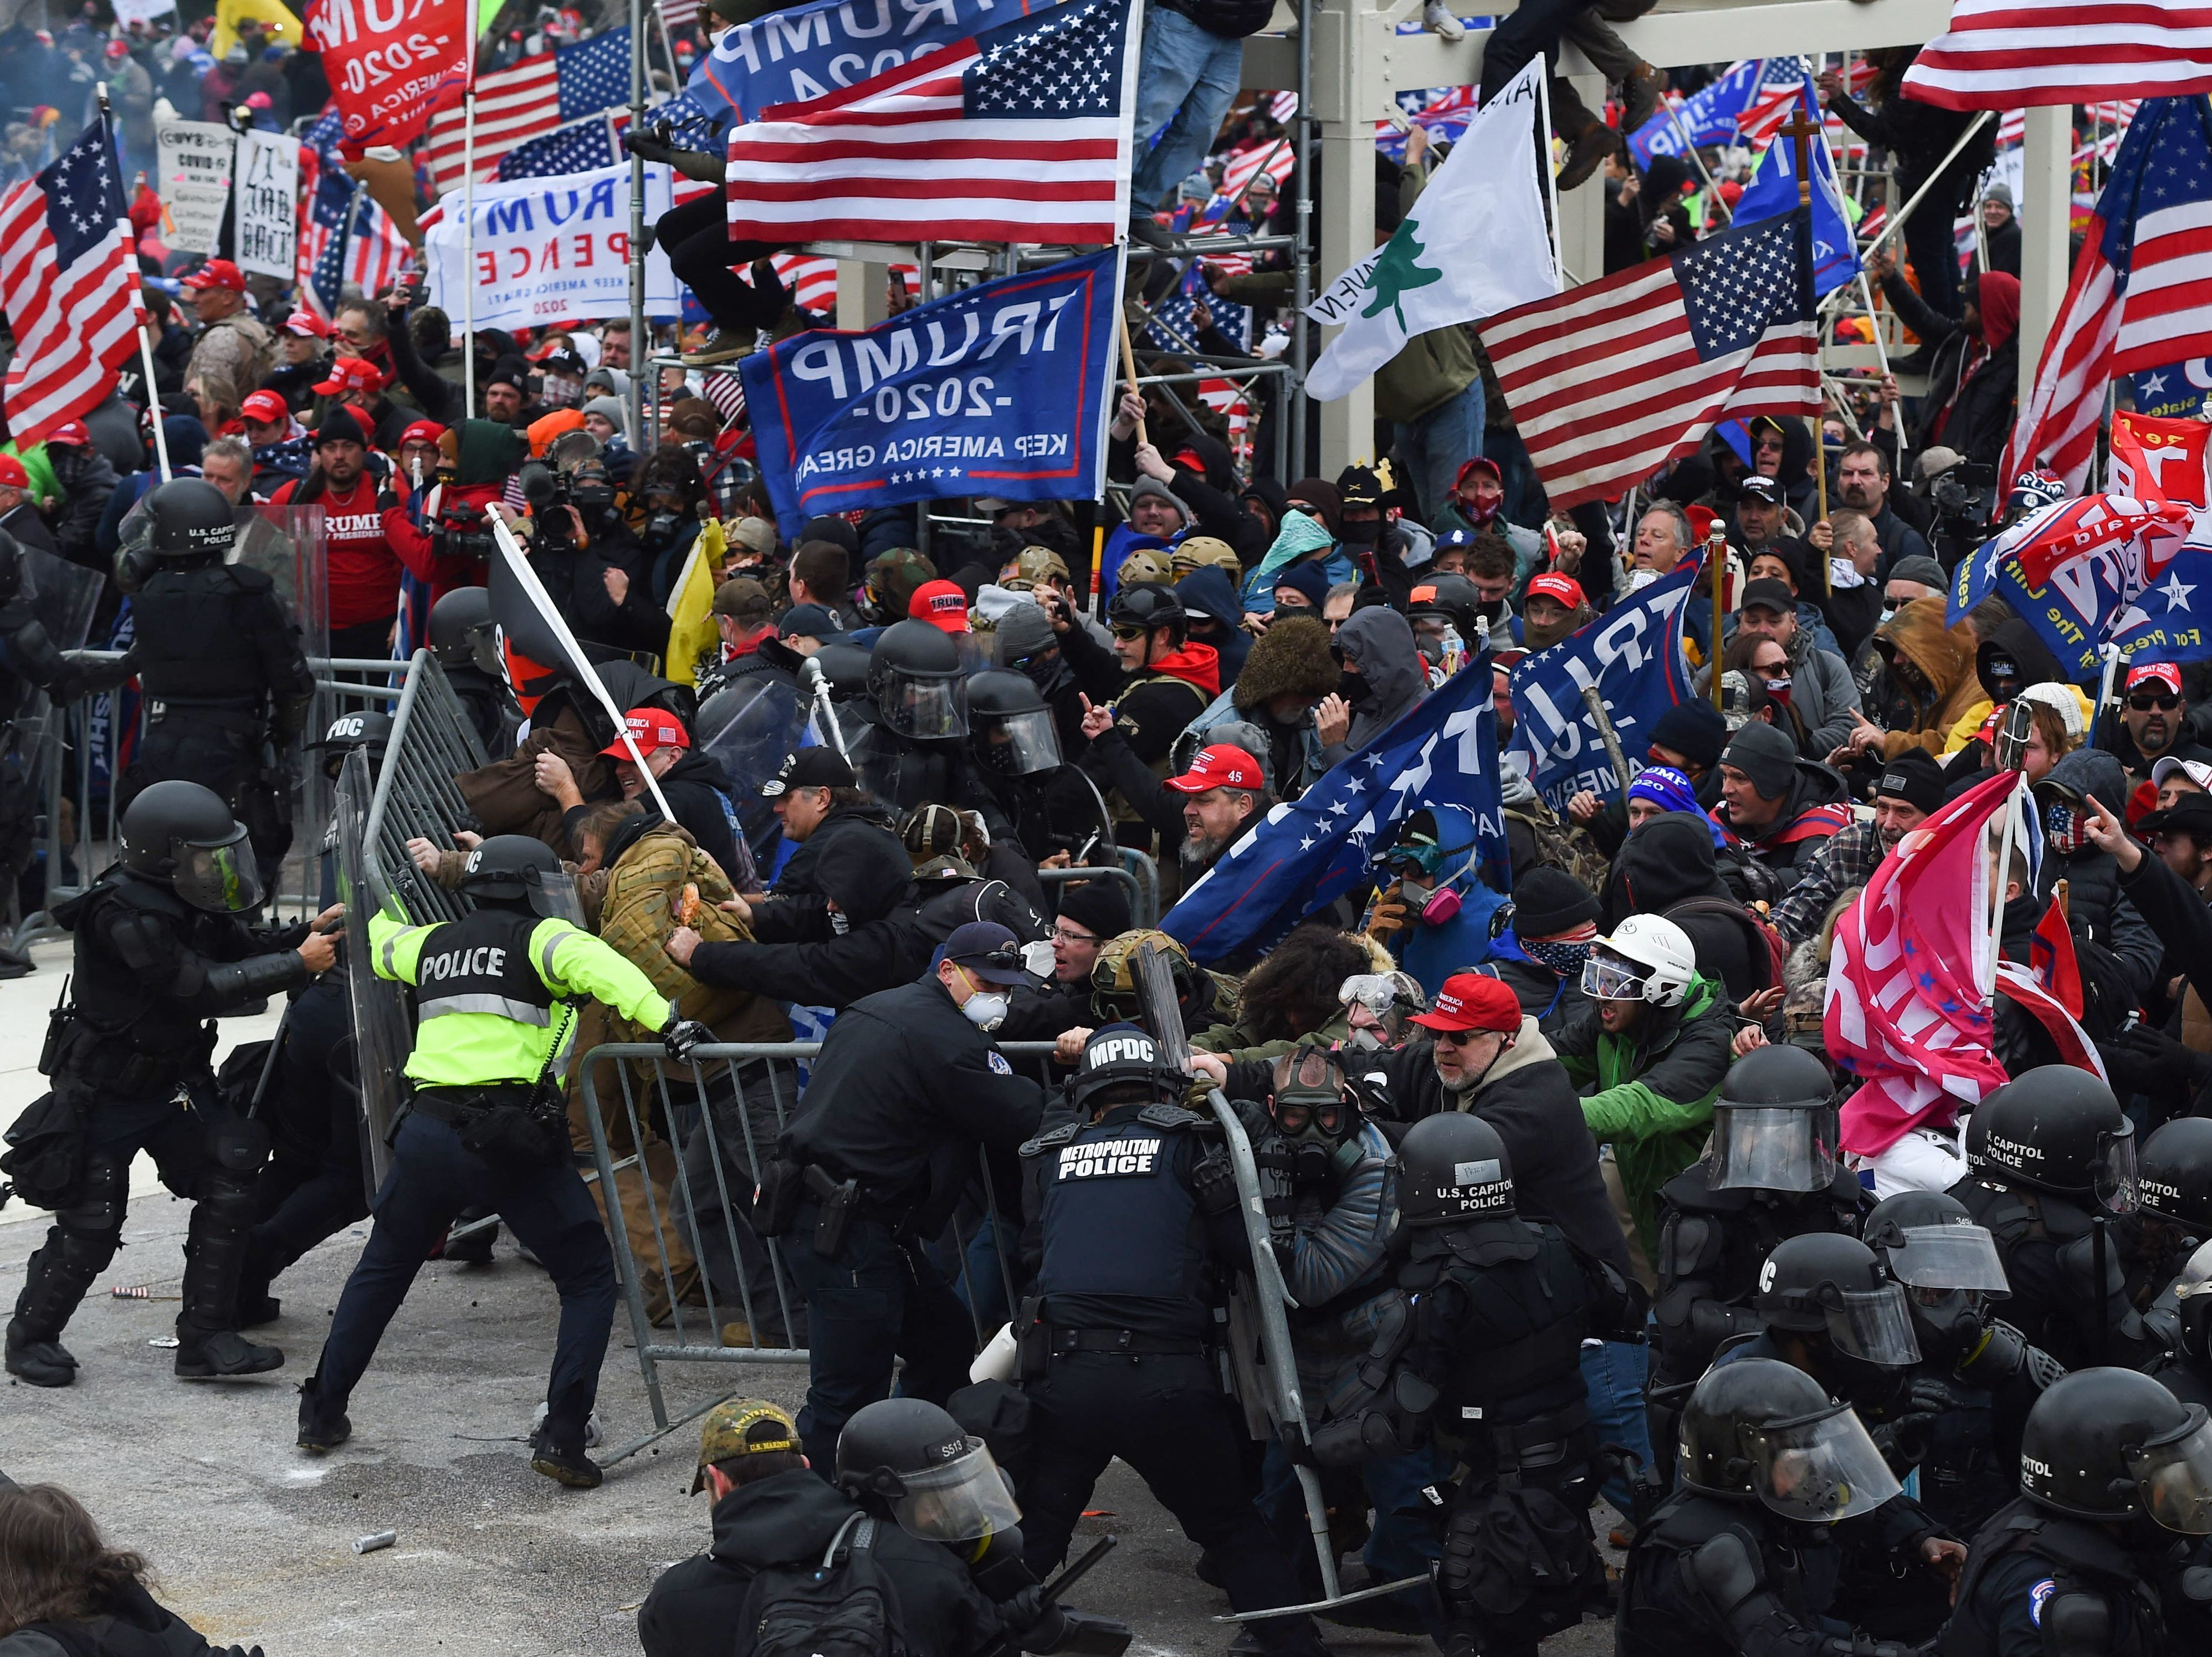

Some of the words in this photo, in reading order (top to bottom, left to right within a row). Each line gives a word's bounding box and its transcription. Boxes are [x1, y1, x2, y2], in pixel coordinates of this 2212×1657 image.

[325, 513, 381, 533] RUMP
[203, 535, 233, 545] POLICE
[931, 597, 964, 608] TRUMP
[326, 718, 364, 743] PDC
[624, 718, 649, 728] MERICA
[1228, 770, 1242, 783] 45
[421, 946, 506, 985] POLICE
[1089, 1038, 1154, 1070] MPDC
[1059, 1139, 1161, 1163] METROPOLITAN
[1986, 1144, 2023, 1168] POLICE
[1994, 1136, 2045, 1160] CAPITOL
[1058, 1155, 1153, 1180] POLICE
[1437, 1187, 1464, 1199] U.S.
[1468, 1178, 1513, 1197] CAPITOL
[2139, 1177, 2181, 1199] APITOL
[1460, 1194, 1506, 1210] POLICE
[943, 1439, 963, 1458] S513
